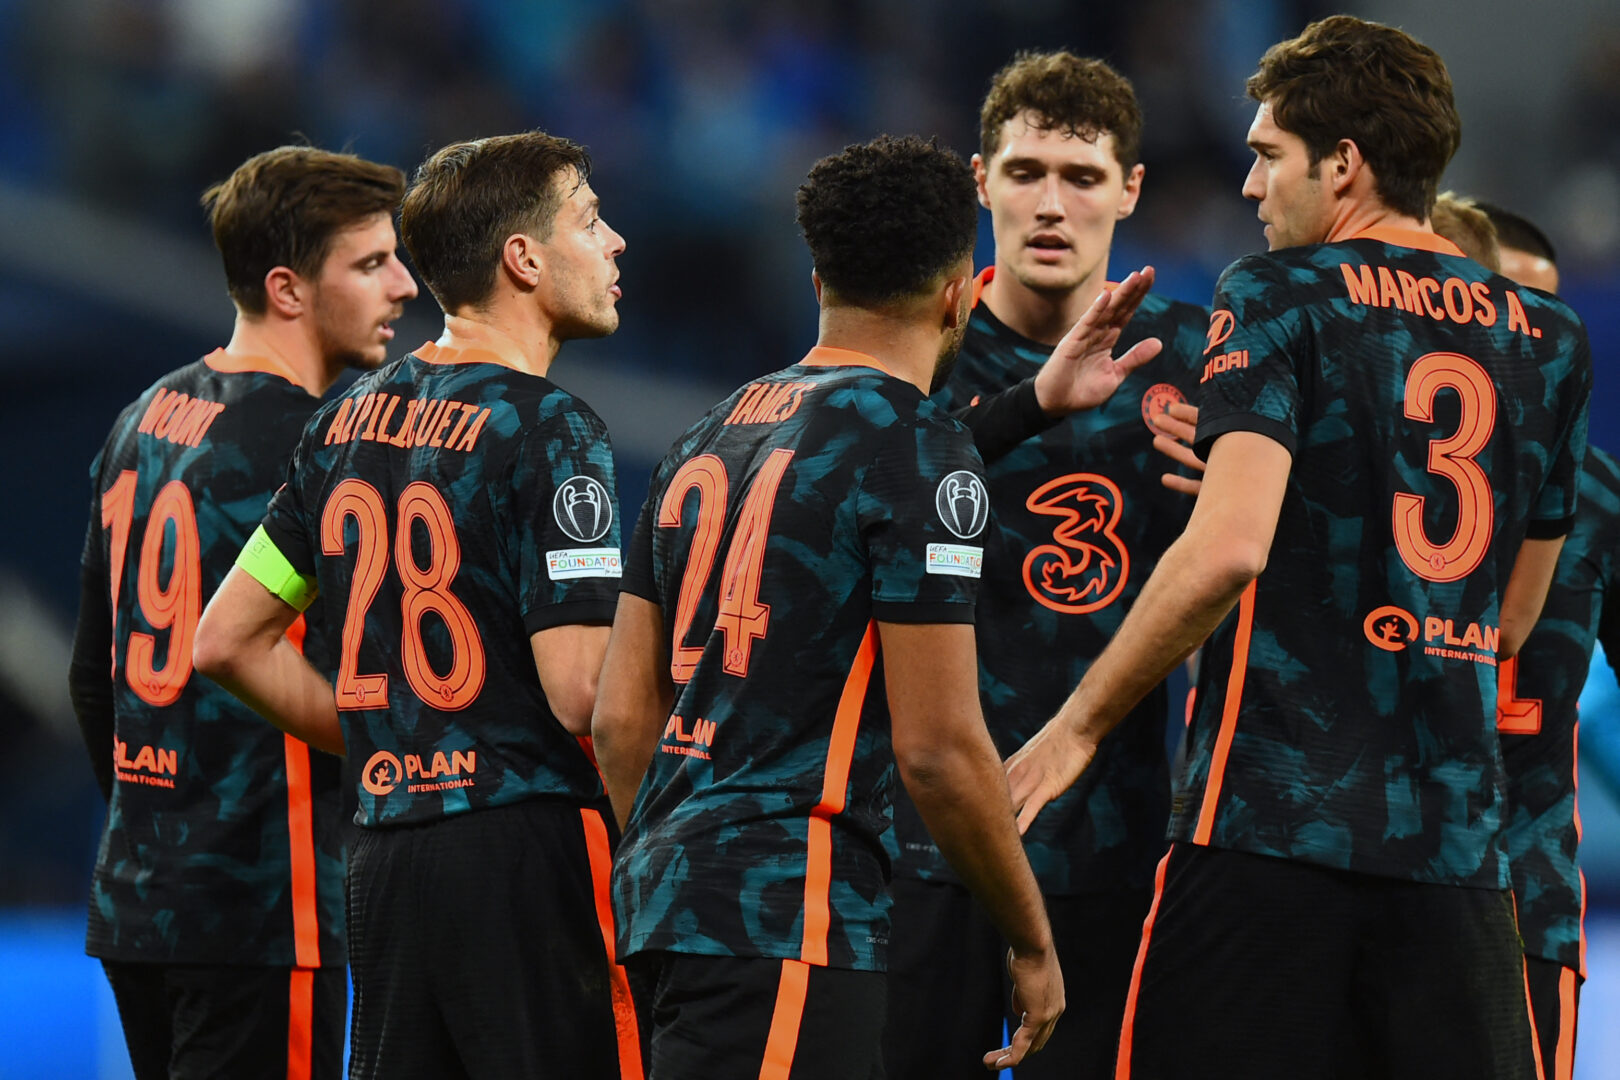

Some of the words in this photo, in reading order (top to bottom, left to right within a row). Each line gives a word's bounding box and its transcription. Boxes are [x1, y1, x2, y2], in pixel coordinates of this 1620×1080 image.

[1339, 262, 1497, 327] MARCOS
[1505, 290, 1542, 339] A.
[137, 387, 226, 449] MOUNT
[723, 382, 818, 426] JAMES
[1392, 351, 1497, 583] 3
[549, 551, 569, 560] UEFA
[550, 556, 621, 570] FOUNDATIO
[658, 447, 795, 684] 24
[929, 552, 983, 568] FOUNDATIO
[101, 469, 200, 706] 19
[320, 478, 486, 712] 28
[1424, 616, 1500, 653] PLAN
[664, 714, 717, 747] PLAN
[404, 750, 477, 780] PLAN
[407, 777, 476, 794] INTERNATIONAL
